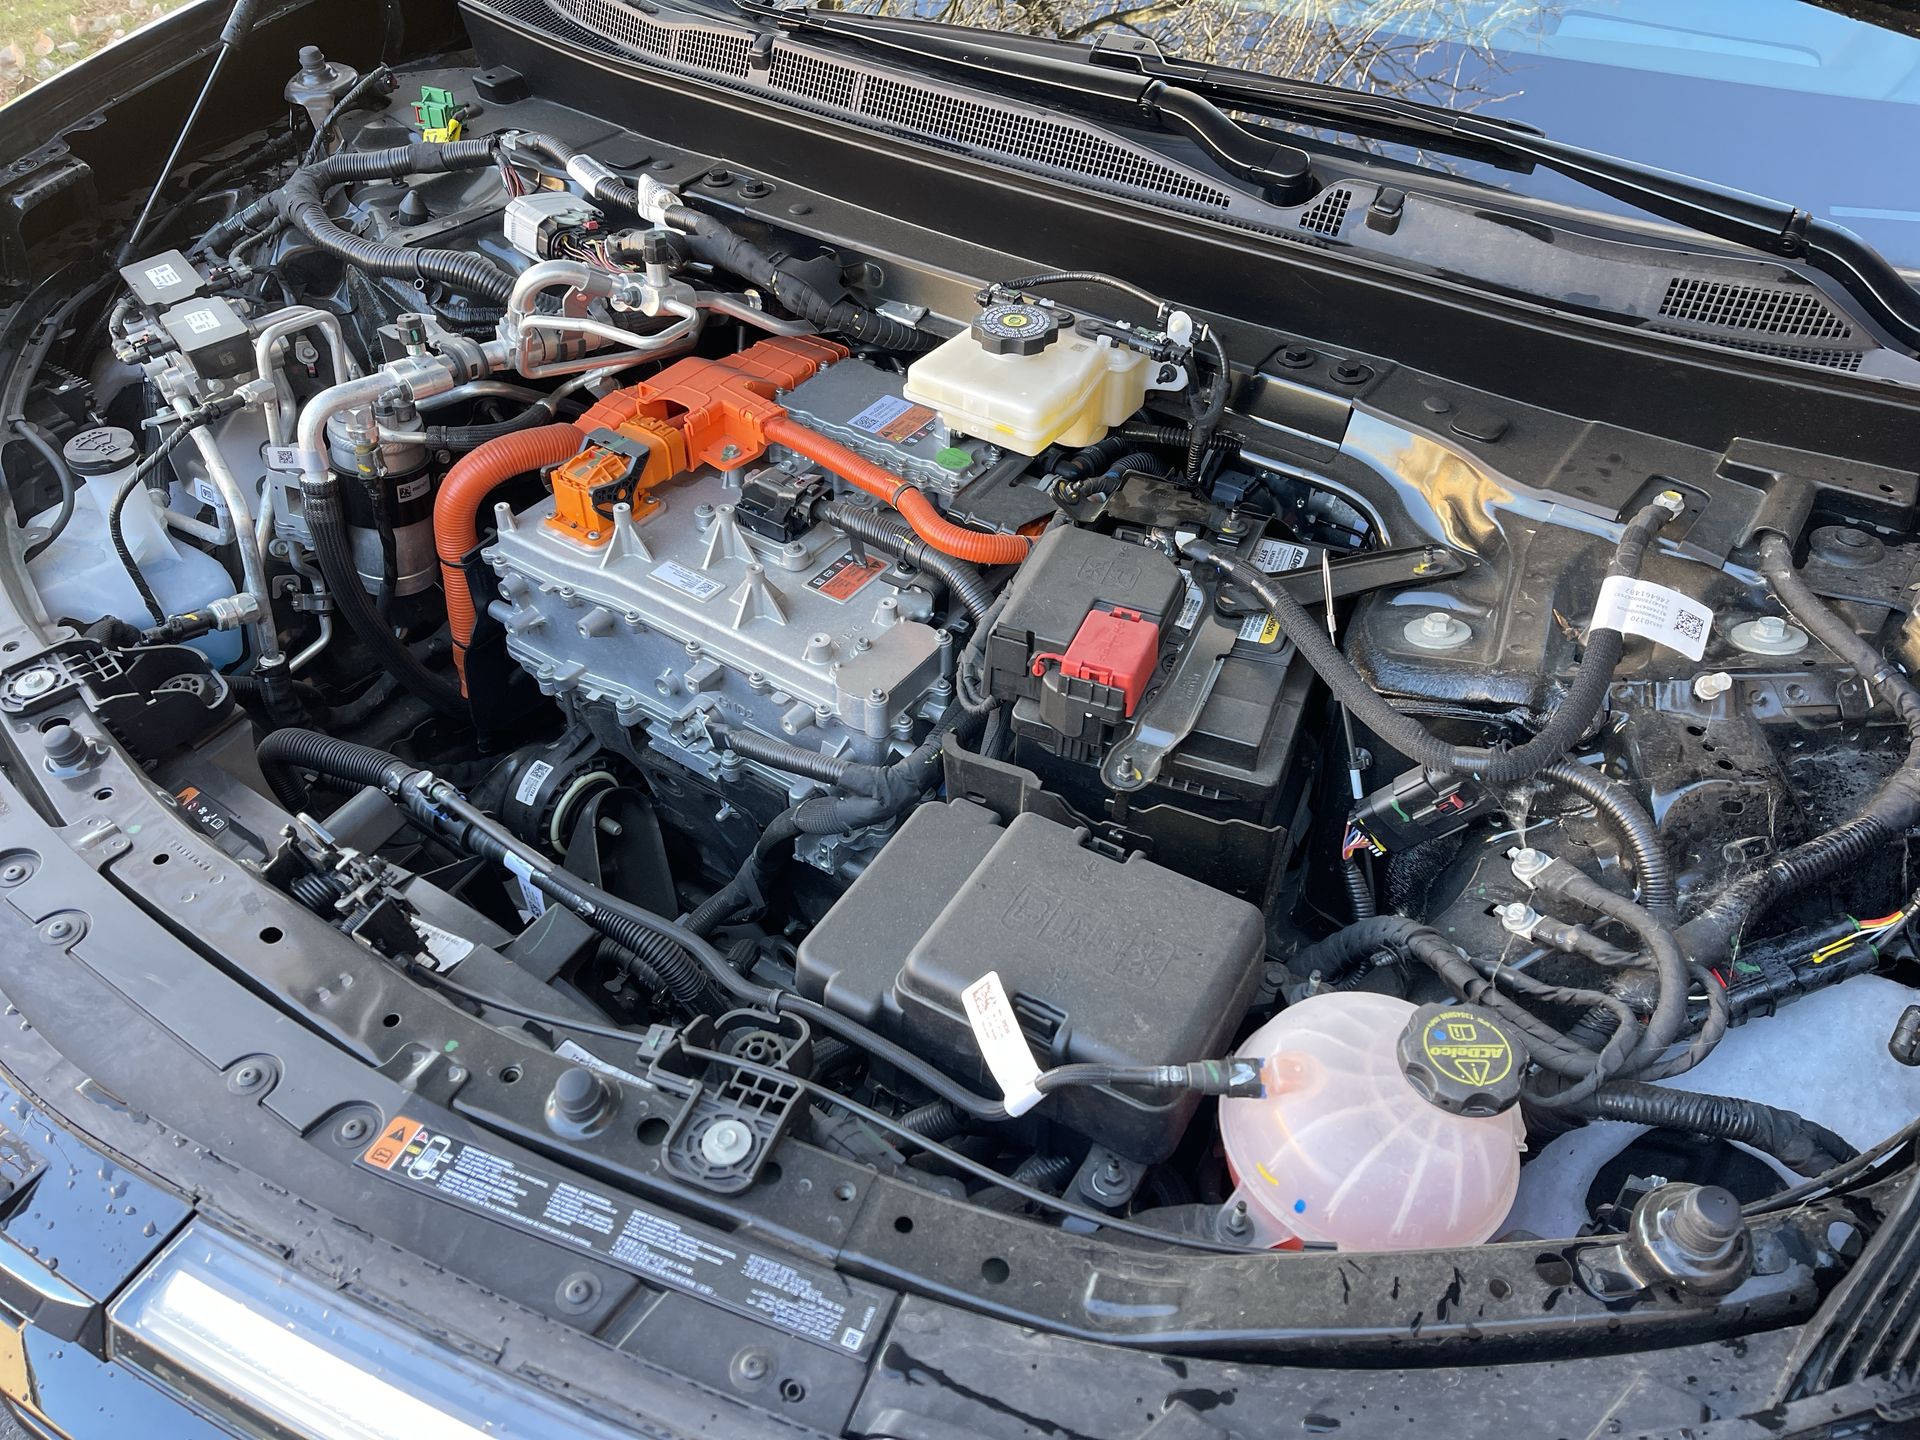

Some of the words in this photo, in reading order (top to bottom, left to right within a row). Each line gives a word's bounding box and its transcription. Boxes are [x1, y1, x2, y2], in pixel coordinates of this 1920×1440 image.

[1257, 549, 1269, 563] 5772
[1289, 549, 1304, 570] ACDe
[1265, 617, 1276, 636] OISON
[1430, 1046, 1504, 1059] ACDelco
